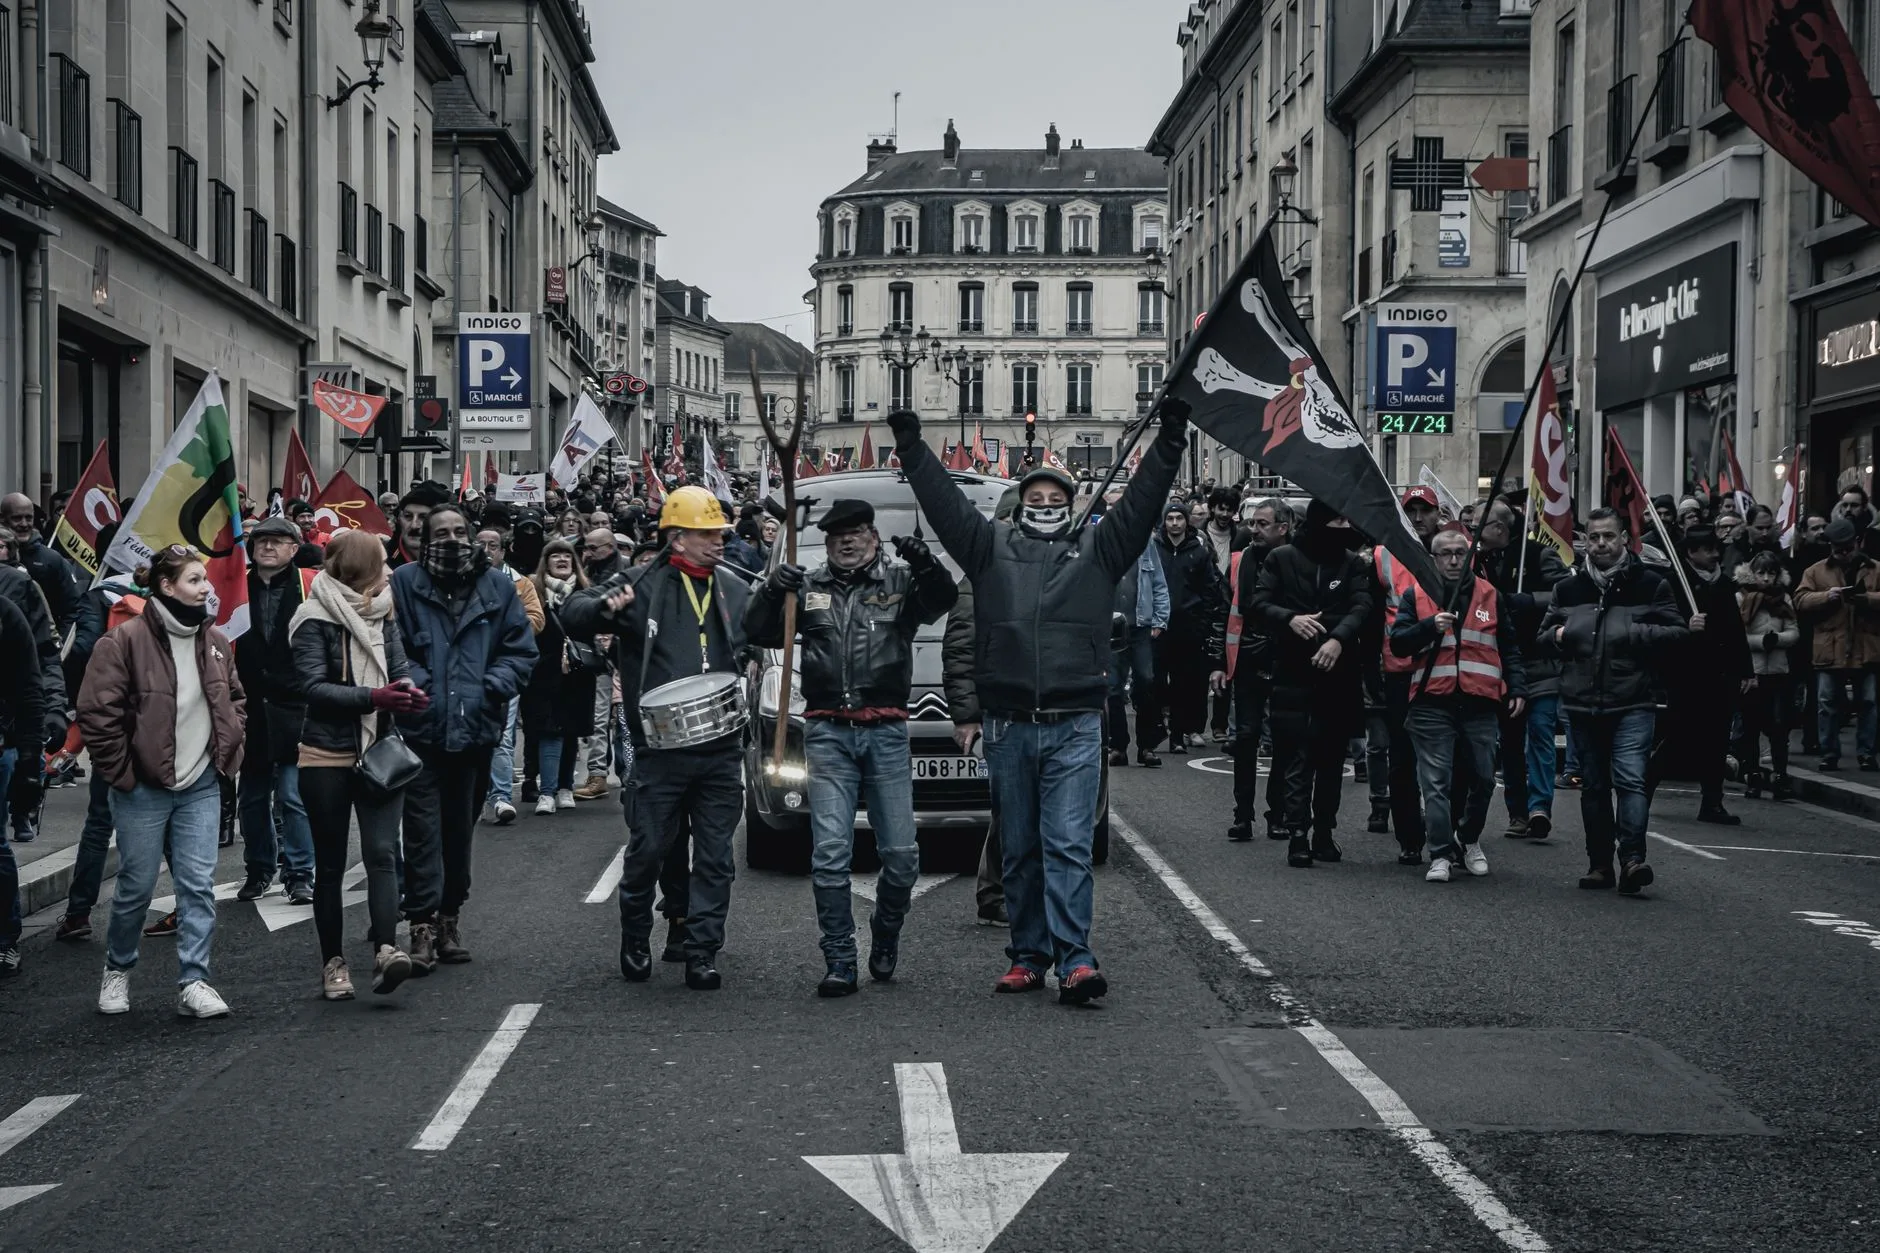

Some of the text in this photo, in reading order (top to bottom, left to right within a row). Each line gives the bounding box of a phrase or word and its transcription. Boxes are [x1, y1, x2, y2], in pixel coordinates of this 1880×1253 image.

[1388, 309, 1448, 323] INDIGO
[468, 318, 522, 330] INDIGO
[469, 340, 506, 387] P
[1387, 333, 1429, 386] P
[485, 392, 523, 402] MARCHÉ
[1404, 393, 1445, 403] MARCHÉ
[477, 415, 514, 423] BOUTIQUE
[664, 427, 674, 456] fnac
[1411, 489, 1425, 497] cgt
[67, 534, 80, 554] UL
[1475, 608, 1490, 623] cgt
[913, 759, 977, 777] -068-PR
[979, 768, 989, 777] 60
